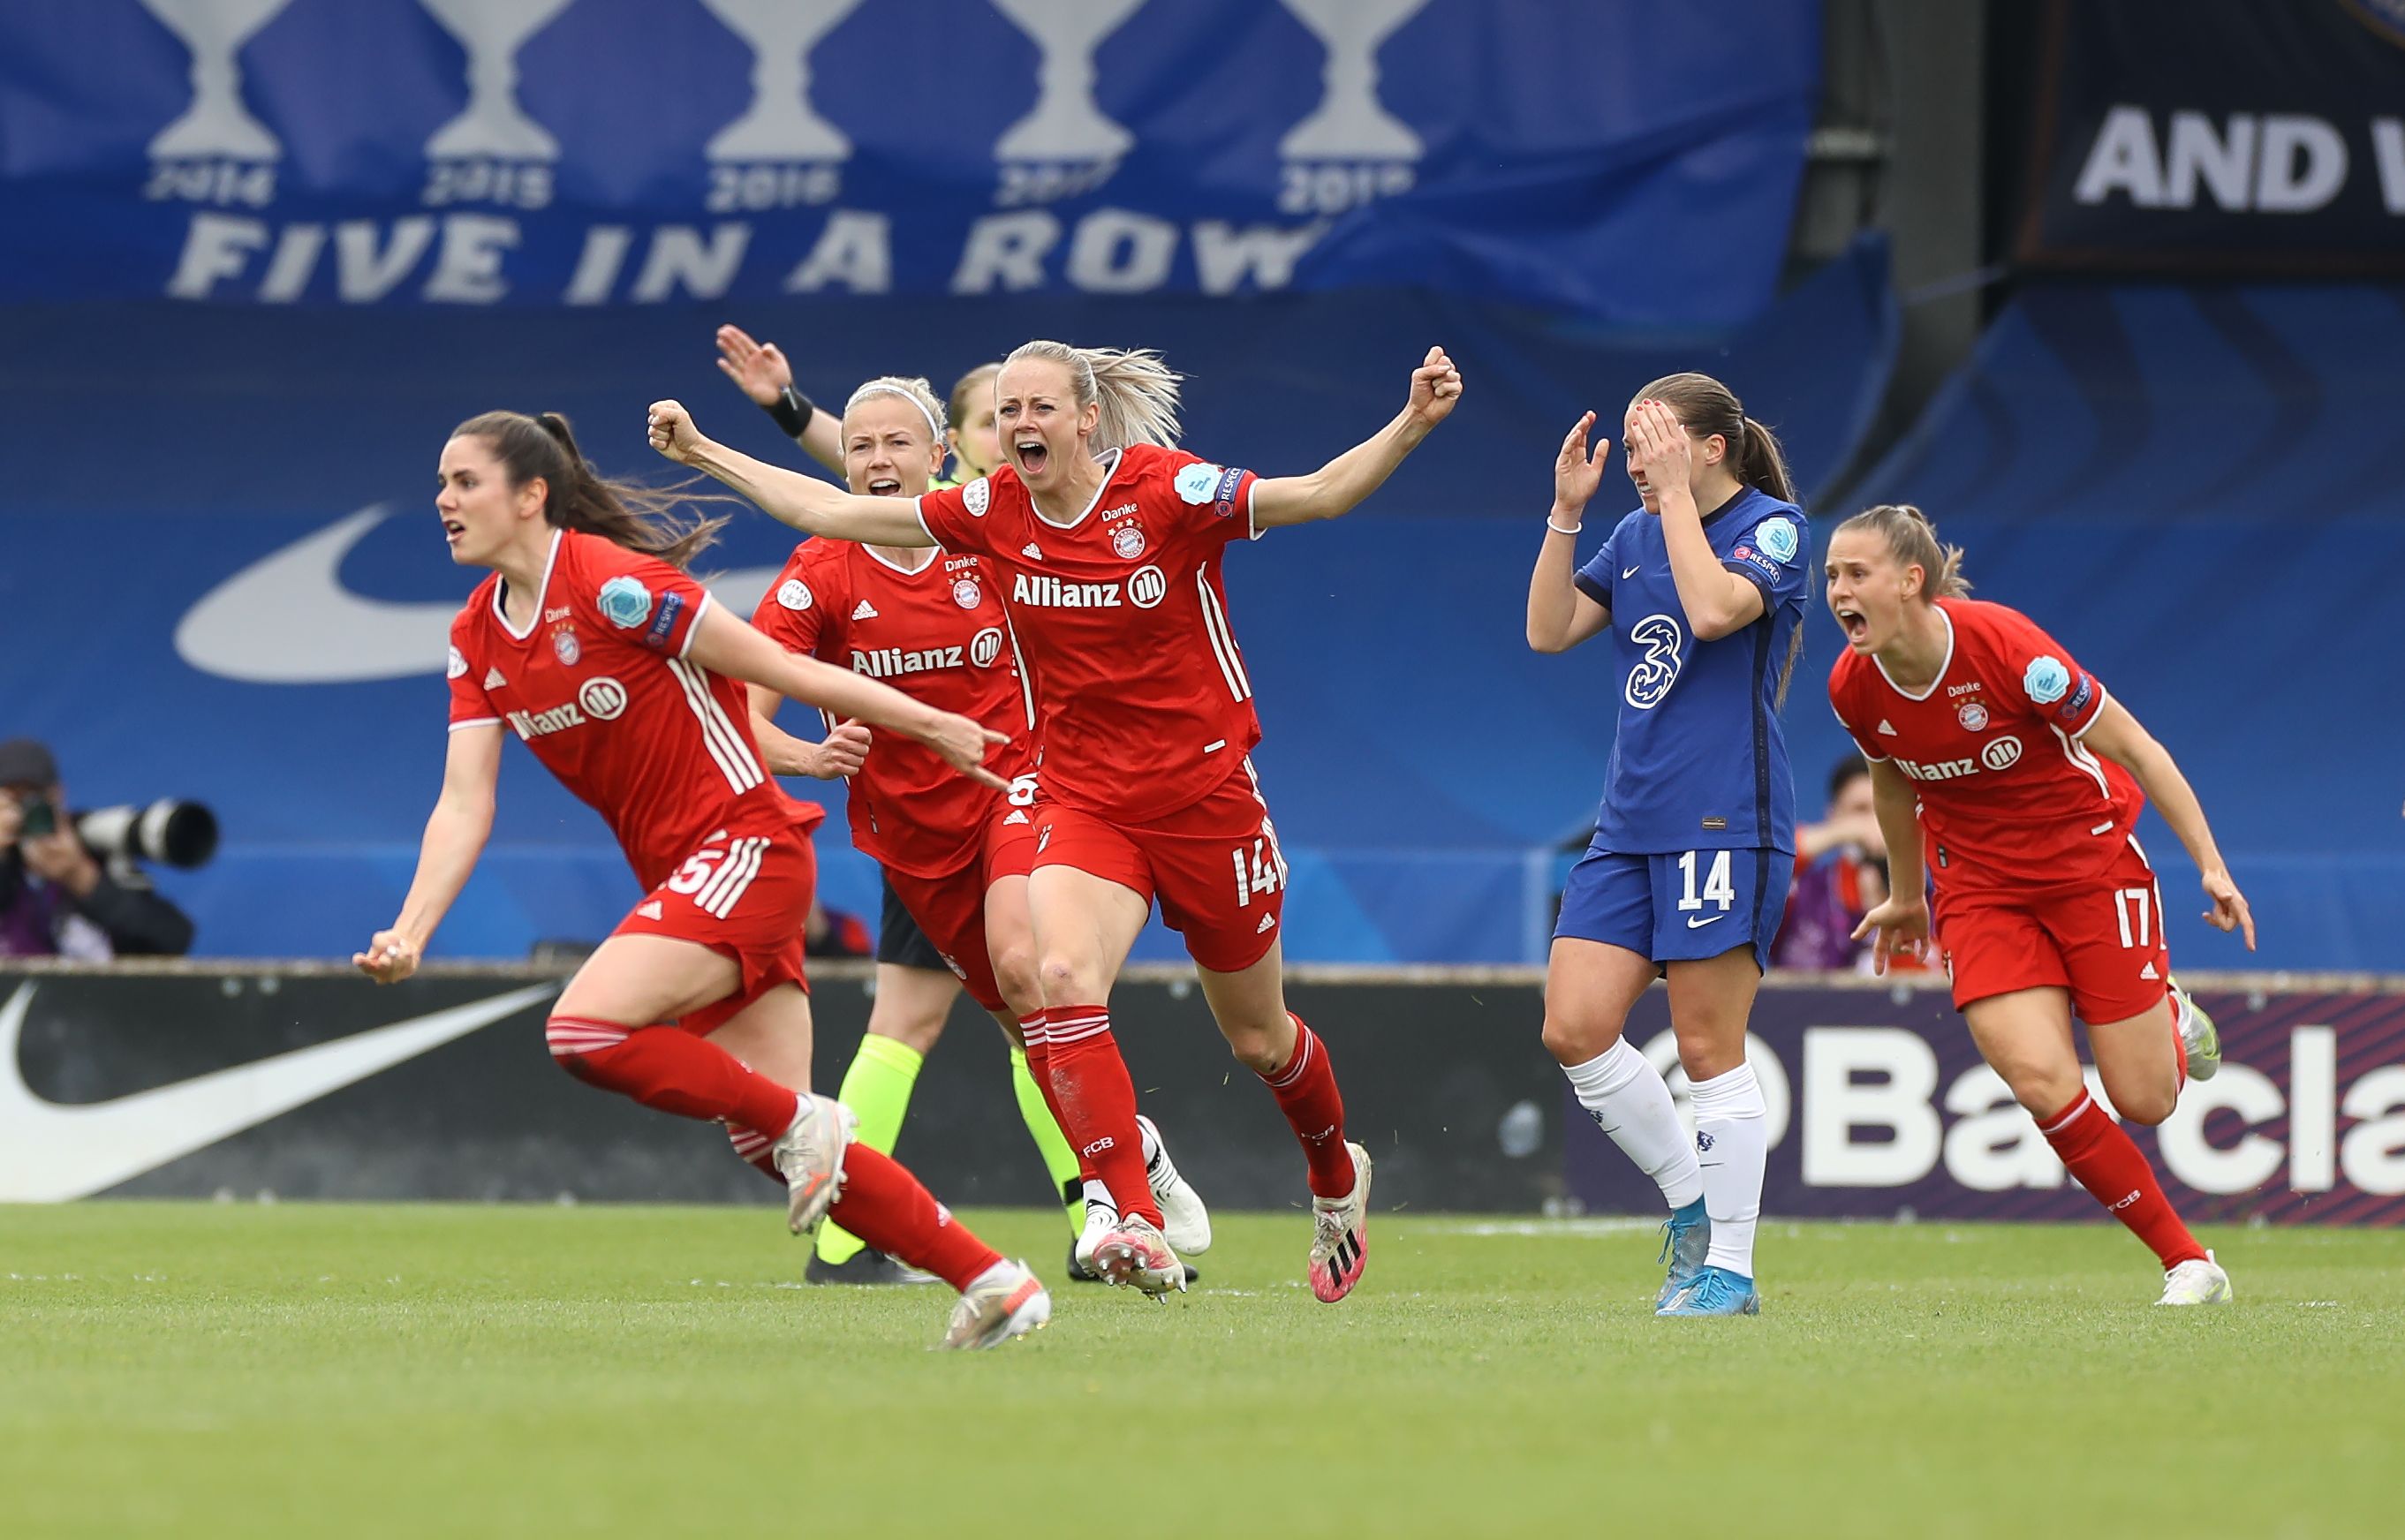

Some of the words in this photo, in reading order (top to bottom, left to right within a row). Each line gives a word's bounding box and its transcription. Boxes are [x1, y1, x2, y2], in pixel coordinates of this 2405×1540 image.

[2072, 103, 2350, 215] AND
[166, 212, 523, 304] FIVE
[563, 223, 753, 306] IN
[783, 208, 891, 295] A
[950, 206, 1332, 297] ROW
[1101, 502, 1138, 523] Danke
[944, 555, 978, 572] Danke
[1013, 573, 1122, 608] Allianz
[851, 645, 964, 677] Allianz
[1947, 682, 1982, 698] Danke
[506, 701, 586, 741] llianz
[1893, 758, 1979, 781] llianz
[1232, 838, 1278, 908] 14
[1678, 849, 1736, 911] 14
[2114, 887, 2150, 948] 17
[1083, 1136, 1115, 1159] FCB
